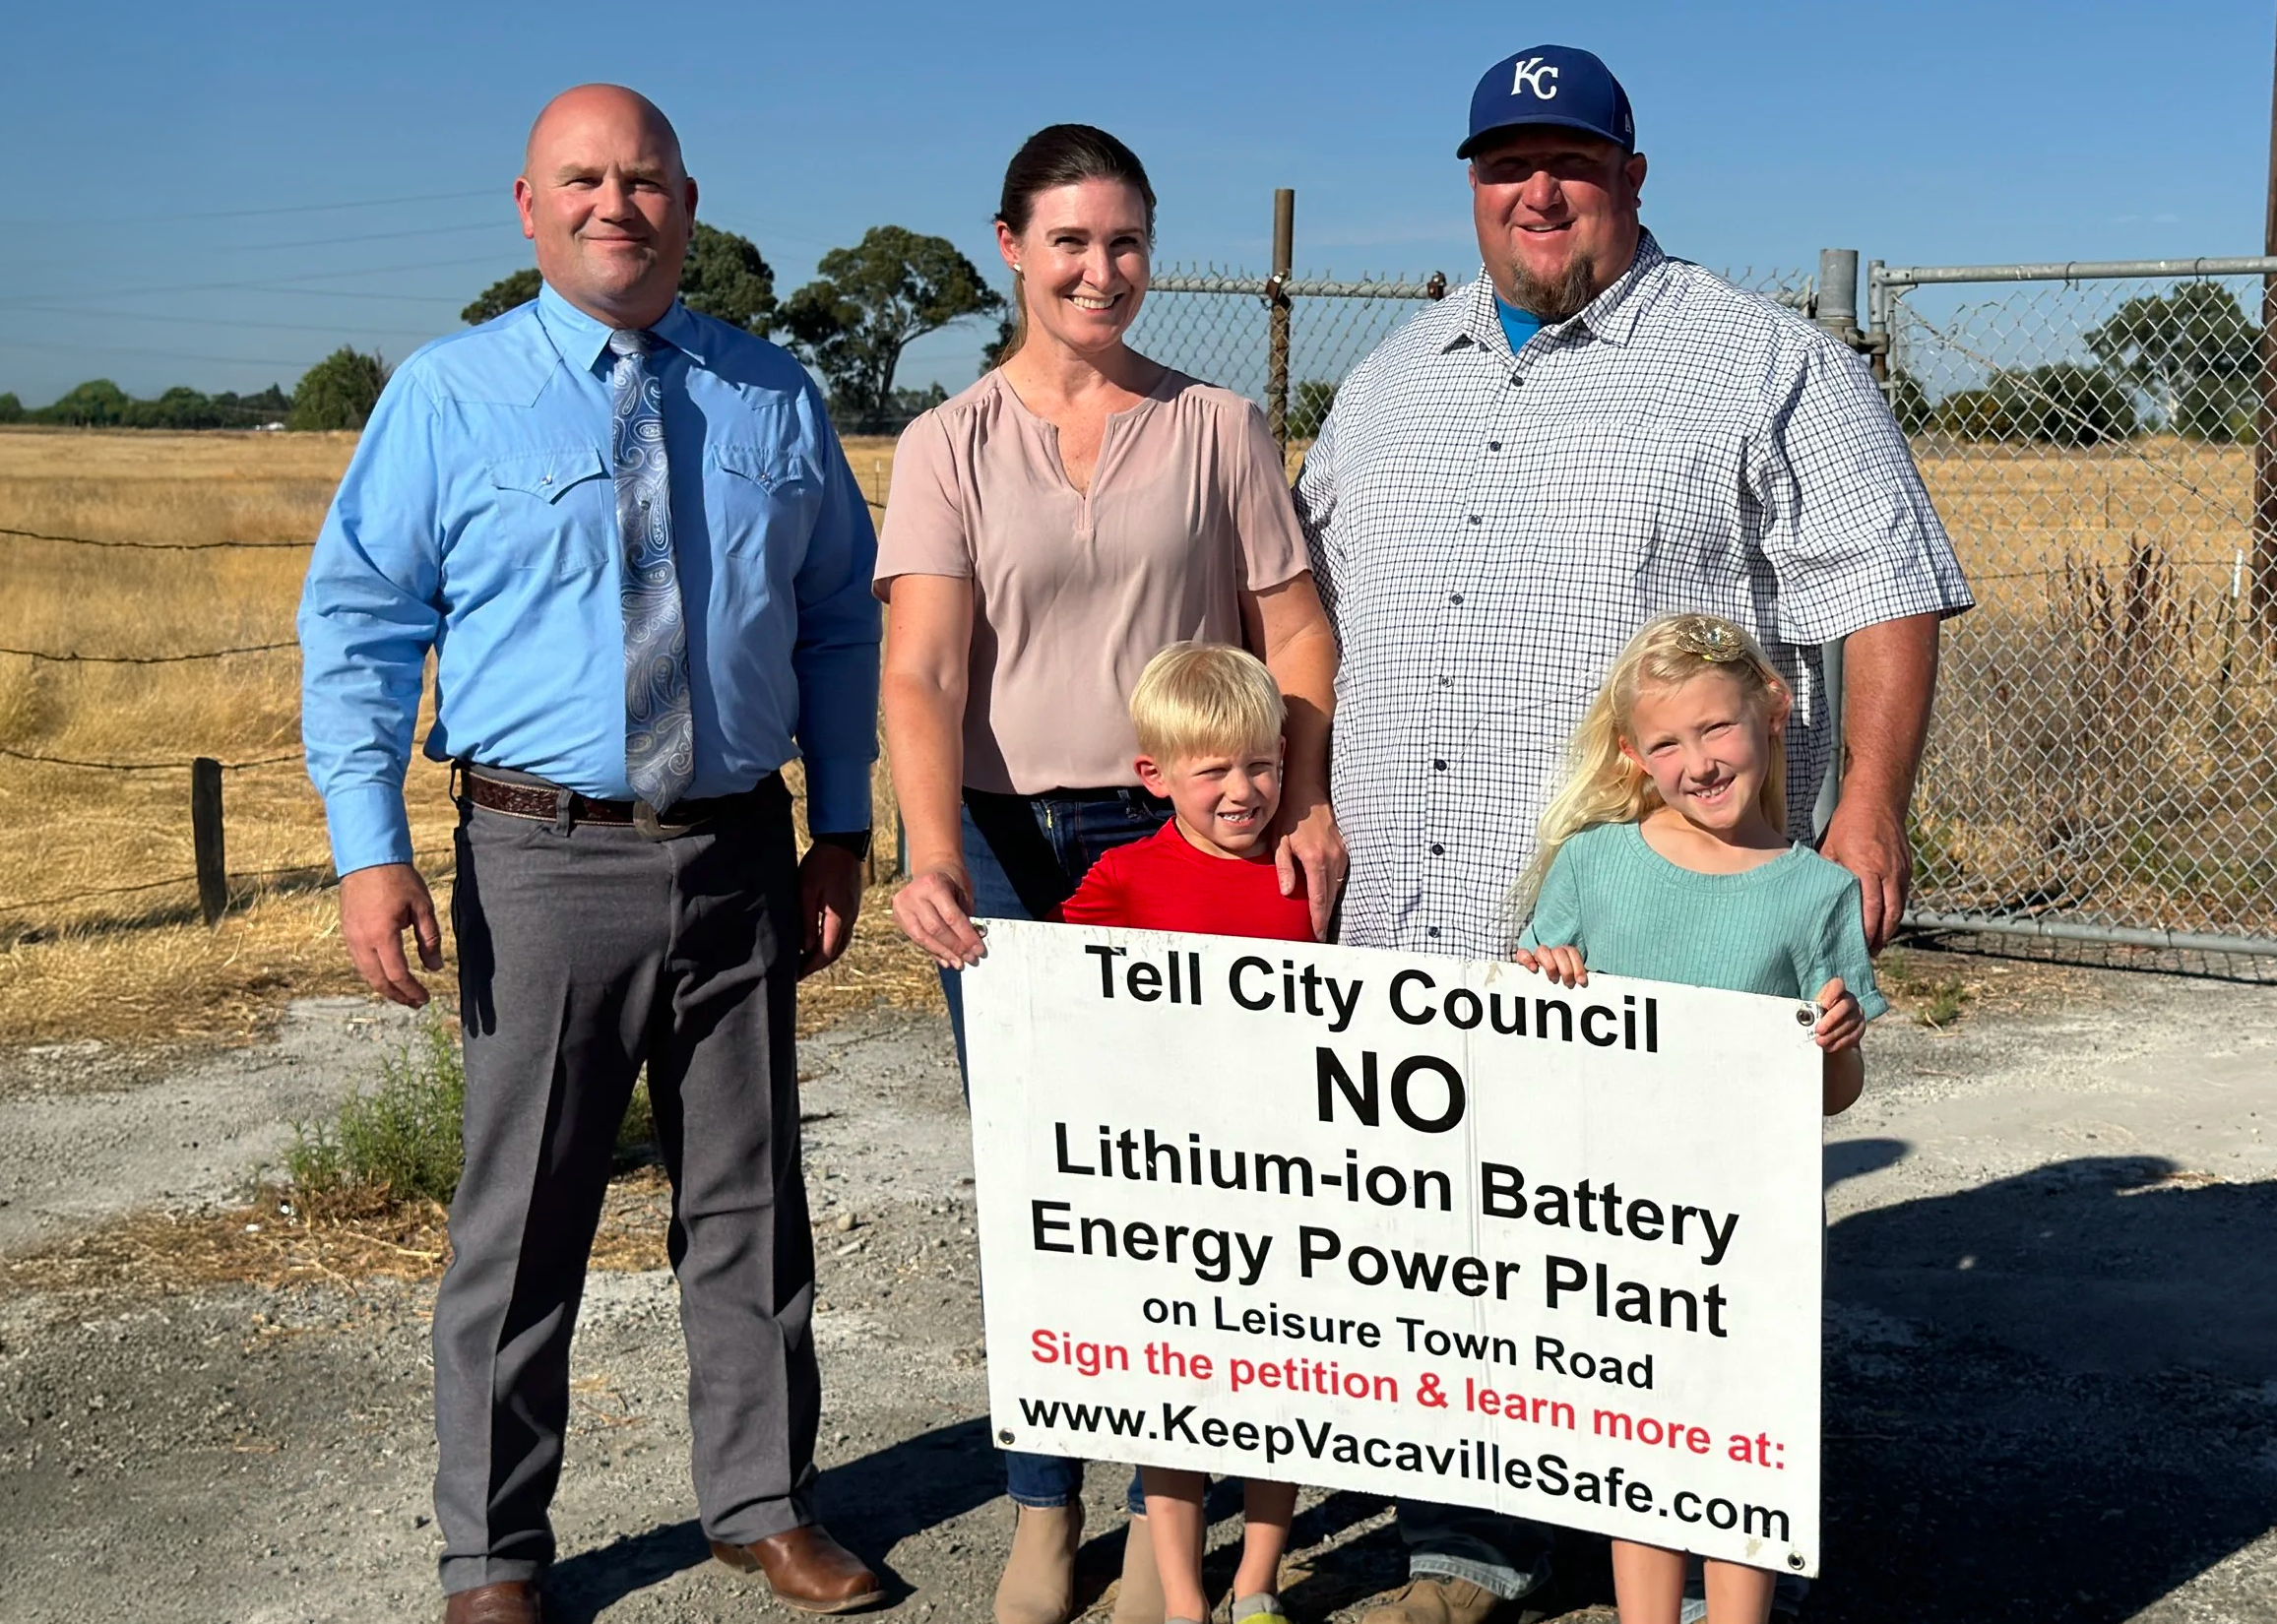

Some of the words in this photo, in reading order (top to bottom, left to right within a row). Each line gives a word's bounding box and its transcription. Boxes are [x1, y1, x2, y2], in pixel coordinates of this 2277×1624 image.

[1511, 57, 1558, 99] KC
[1085, 945, 1201, 1005] Tell
[1230, 956, 1363, 1032] City
[1390, 968, 1659, 1053] Council
[1316, 1047, 1465, 1133] NO
[1055, 1122, 1451, 1211] Lithium-ion
[1482, 1161, 1739, 1266] Battery
[1032, 1200, 1273, 1285] Energy
[1299, 1225, 1520, 1300] Power
[1547, 1255, 1727, 1338] Plant
[1033, 1330, 1128, 1376] Sign
[1145, 1343, 1212, 1379] the
[1231, 1359, 1397, 1402] petition
[1417, 1373, 1448, 1407] &
[1467, 1378, 1574, 1429] learn
[1595, 1409, 1710, 1454] more
[1728, 1433, 1787, 1470] at:
[1143, 1298, 1196, 1327] on
[1215, 1296, 1380, 1347] Leisure
[1396, 1317, 1516, 1365] Town
[1536, 1336, 1652, 1390] Road
[1019, 1397, 1789, 1541] www.KeepVacavilleSafe.com
